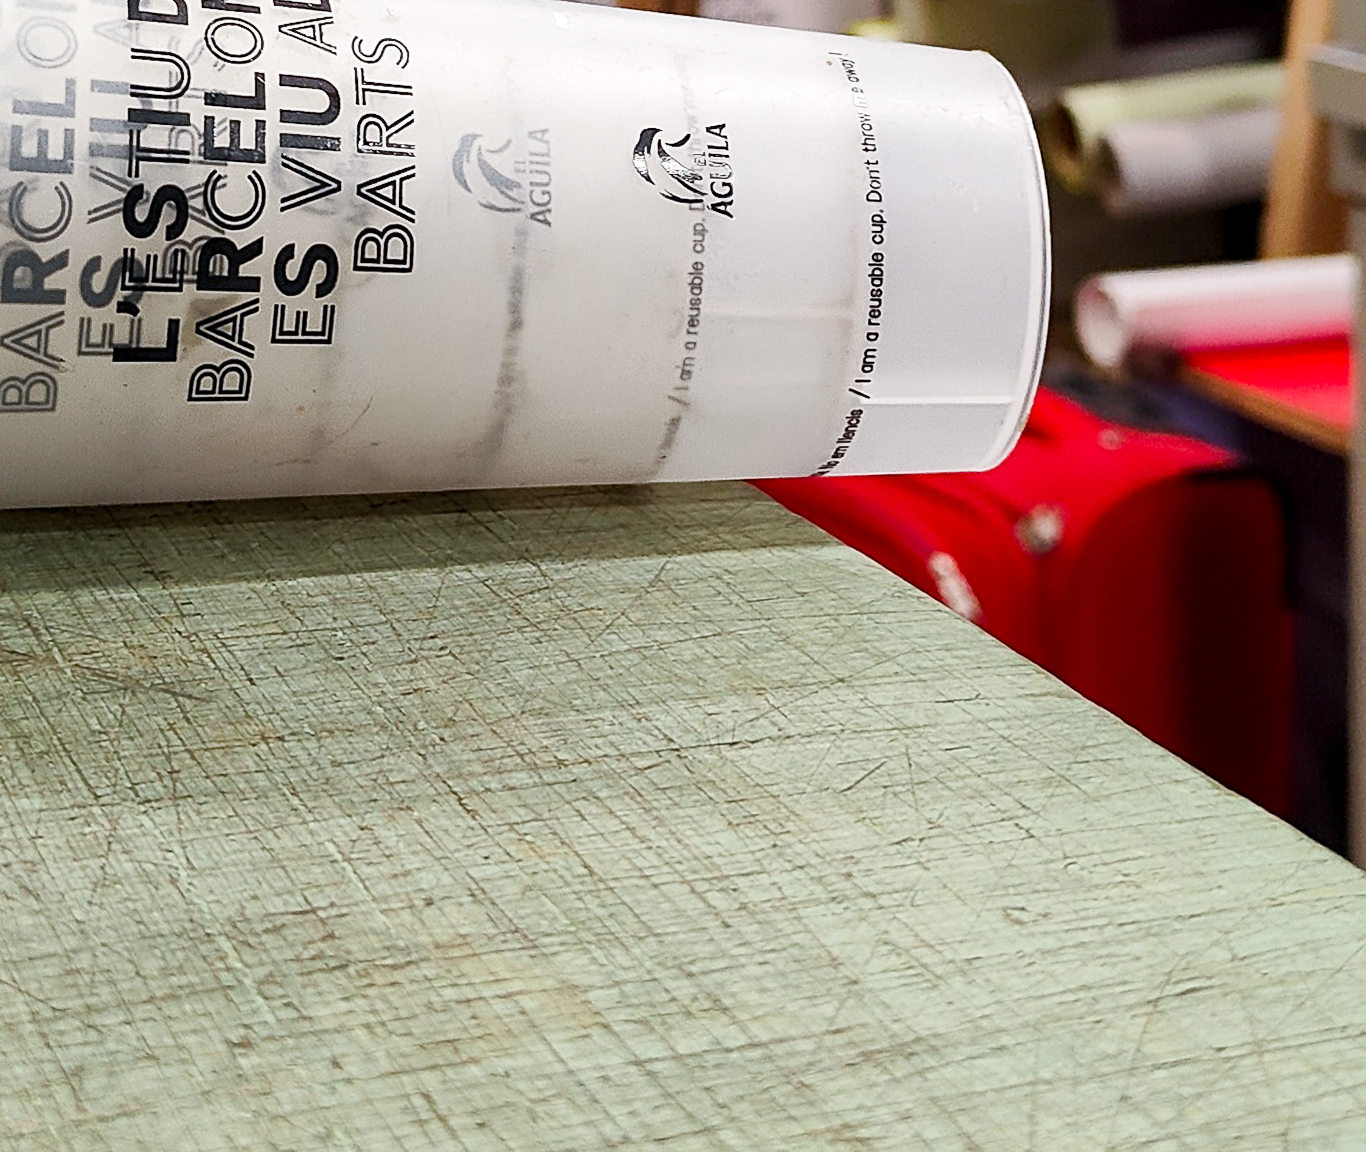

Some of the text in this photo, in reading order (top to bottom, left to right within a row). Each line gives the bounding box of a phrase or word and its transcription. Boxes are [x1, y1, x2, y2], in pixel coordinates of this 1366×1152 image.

[278, 73, 342, 212] VIU
[351, 35, 416, 274] BARTS
[857, 112, 876, 153] throw
[112, 47, 192, 362] L'ESTIU
[705, 123, 734, 219] ÁGUILA
[863, 159, 882, 203] Don't
[870, 209, 887, 245] cup.
[271, 242, 339, 345] ES
[685, 261, 704, 337] reusable
[866, 252, 884, 326] reusable
[861, 348, 877, 374] am
[866, 332, 879, 342] a
